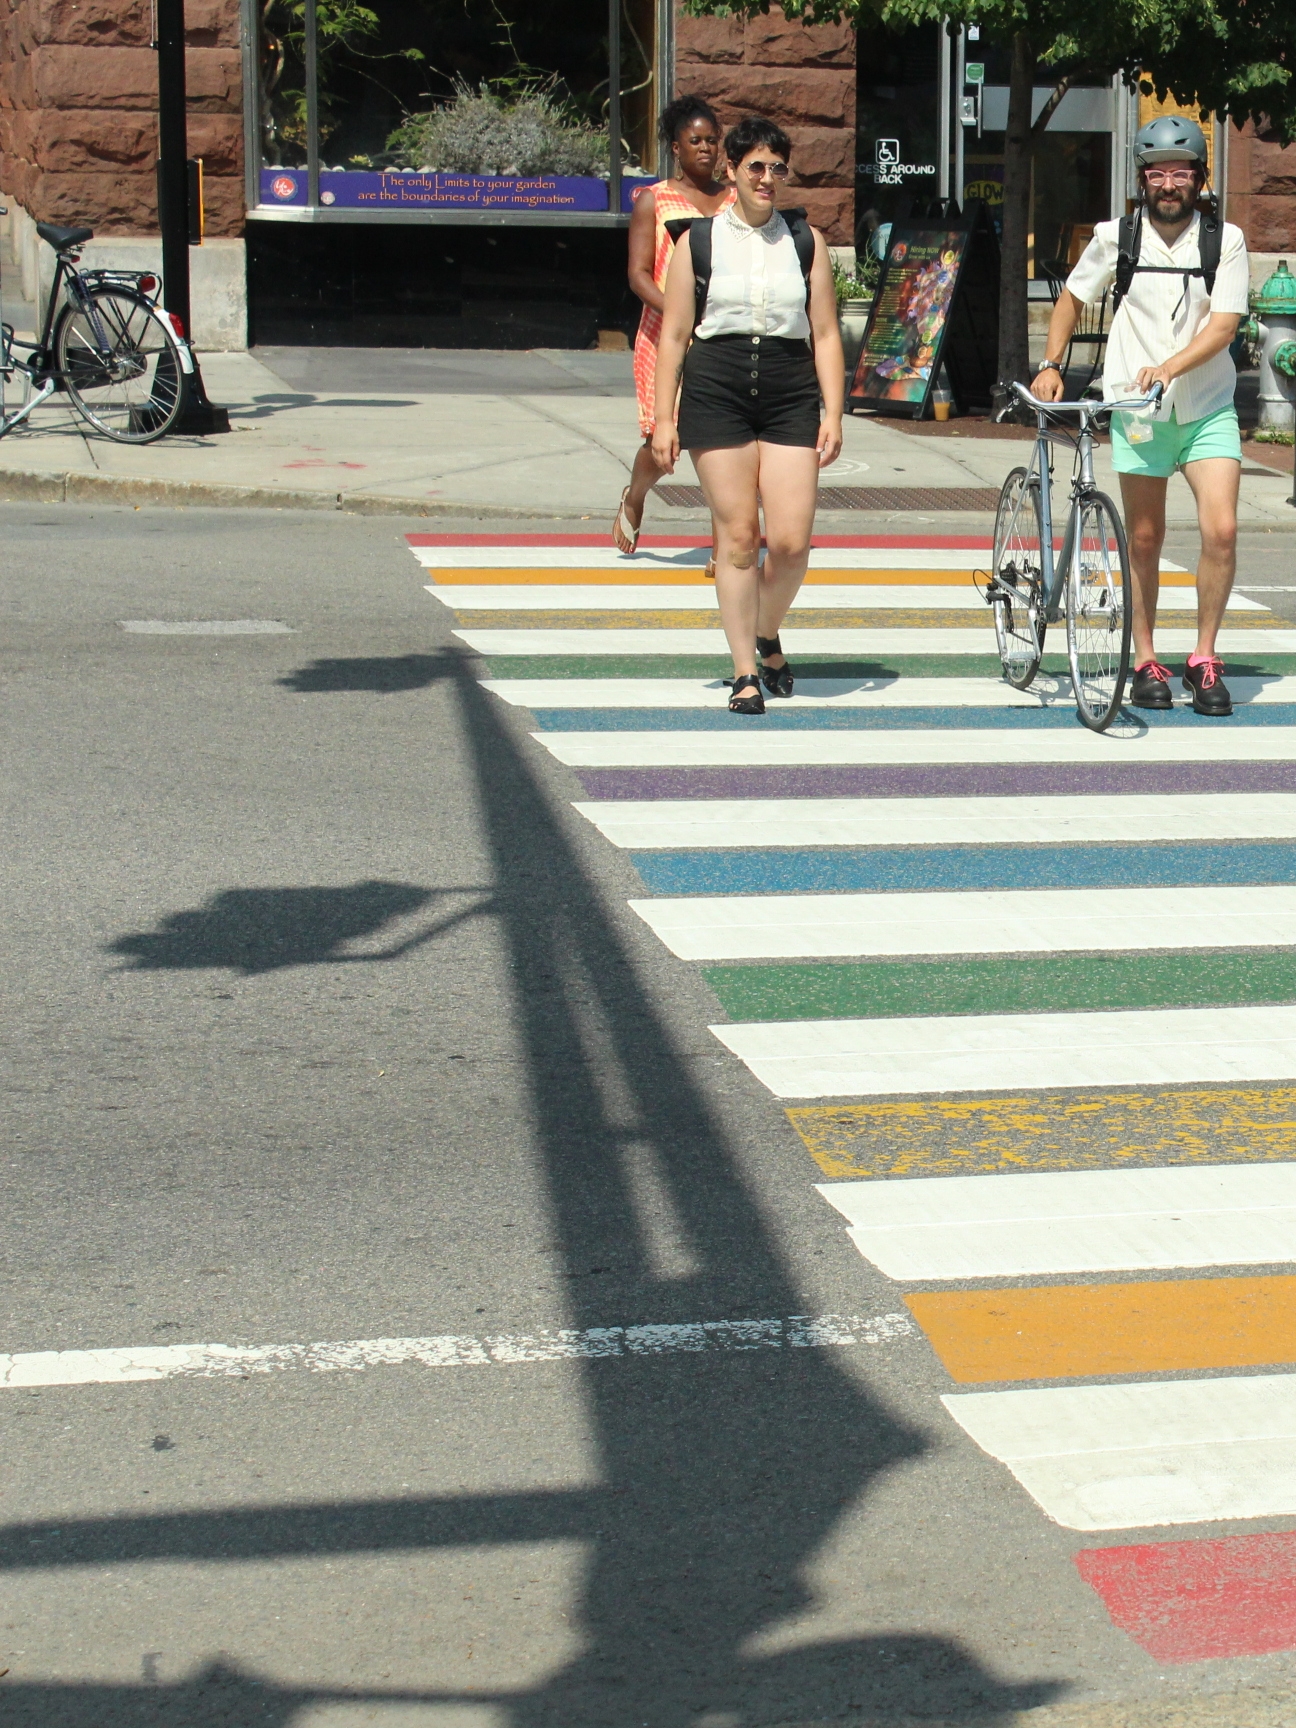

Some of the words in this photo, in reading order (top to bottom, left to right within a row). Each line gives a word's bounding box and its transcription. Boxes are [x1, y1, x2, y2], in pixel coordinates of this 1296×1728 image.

[890, 164, 935, 175] AROUND
[378, 173, 404, 188] The
[407, 173, 432, 191] only
[435, 174, 470, 188] Limits
[473, 178, 485, 188] to
[487, 180, 514, 193] your
[516, 176, 556, 193] garden
[874, 174, 903, 184] BACK
[358, 192, 376, 200] are
[379, 187, 399, 201] the
[401, 188, 466, 202] boundaries
[467, 189, 481, 202] of
[482, 195, 510, 207] your
[511, 192, 575, 208] imagination
[910, 246, 926, 254] Hiring
